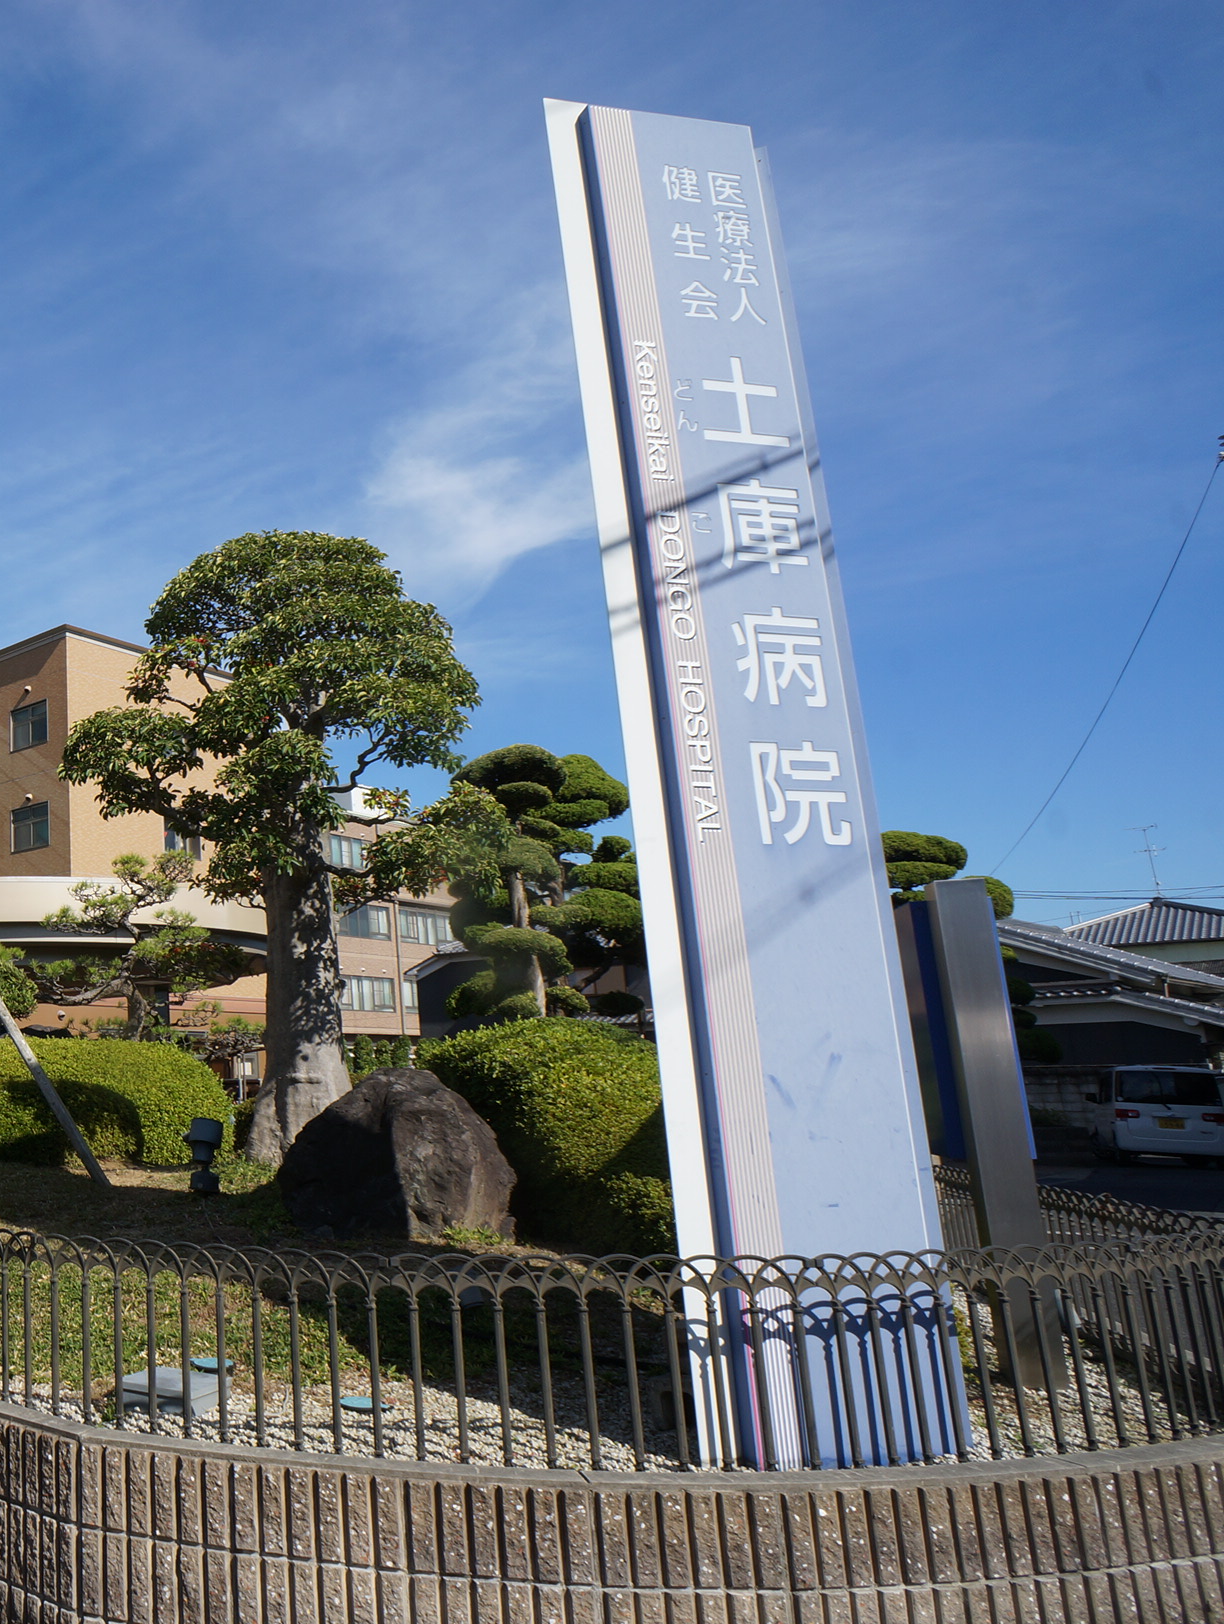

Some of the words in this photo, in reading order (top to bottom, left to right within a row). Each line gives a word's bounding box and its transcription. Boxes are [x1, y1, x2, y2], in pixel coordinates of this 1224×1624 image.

[662, 164, 719, 321] 健生会
[707, 170, 767, 326] 医療法人
[633, 339, 675, 483] Kenseikai
[658, 510, 697, 642] DONGO
[678, 660, 722, 845] HOSPITAL
[702, 356, 853, 846] 土庫病院
